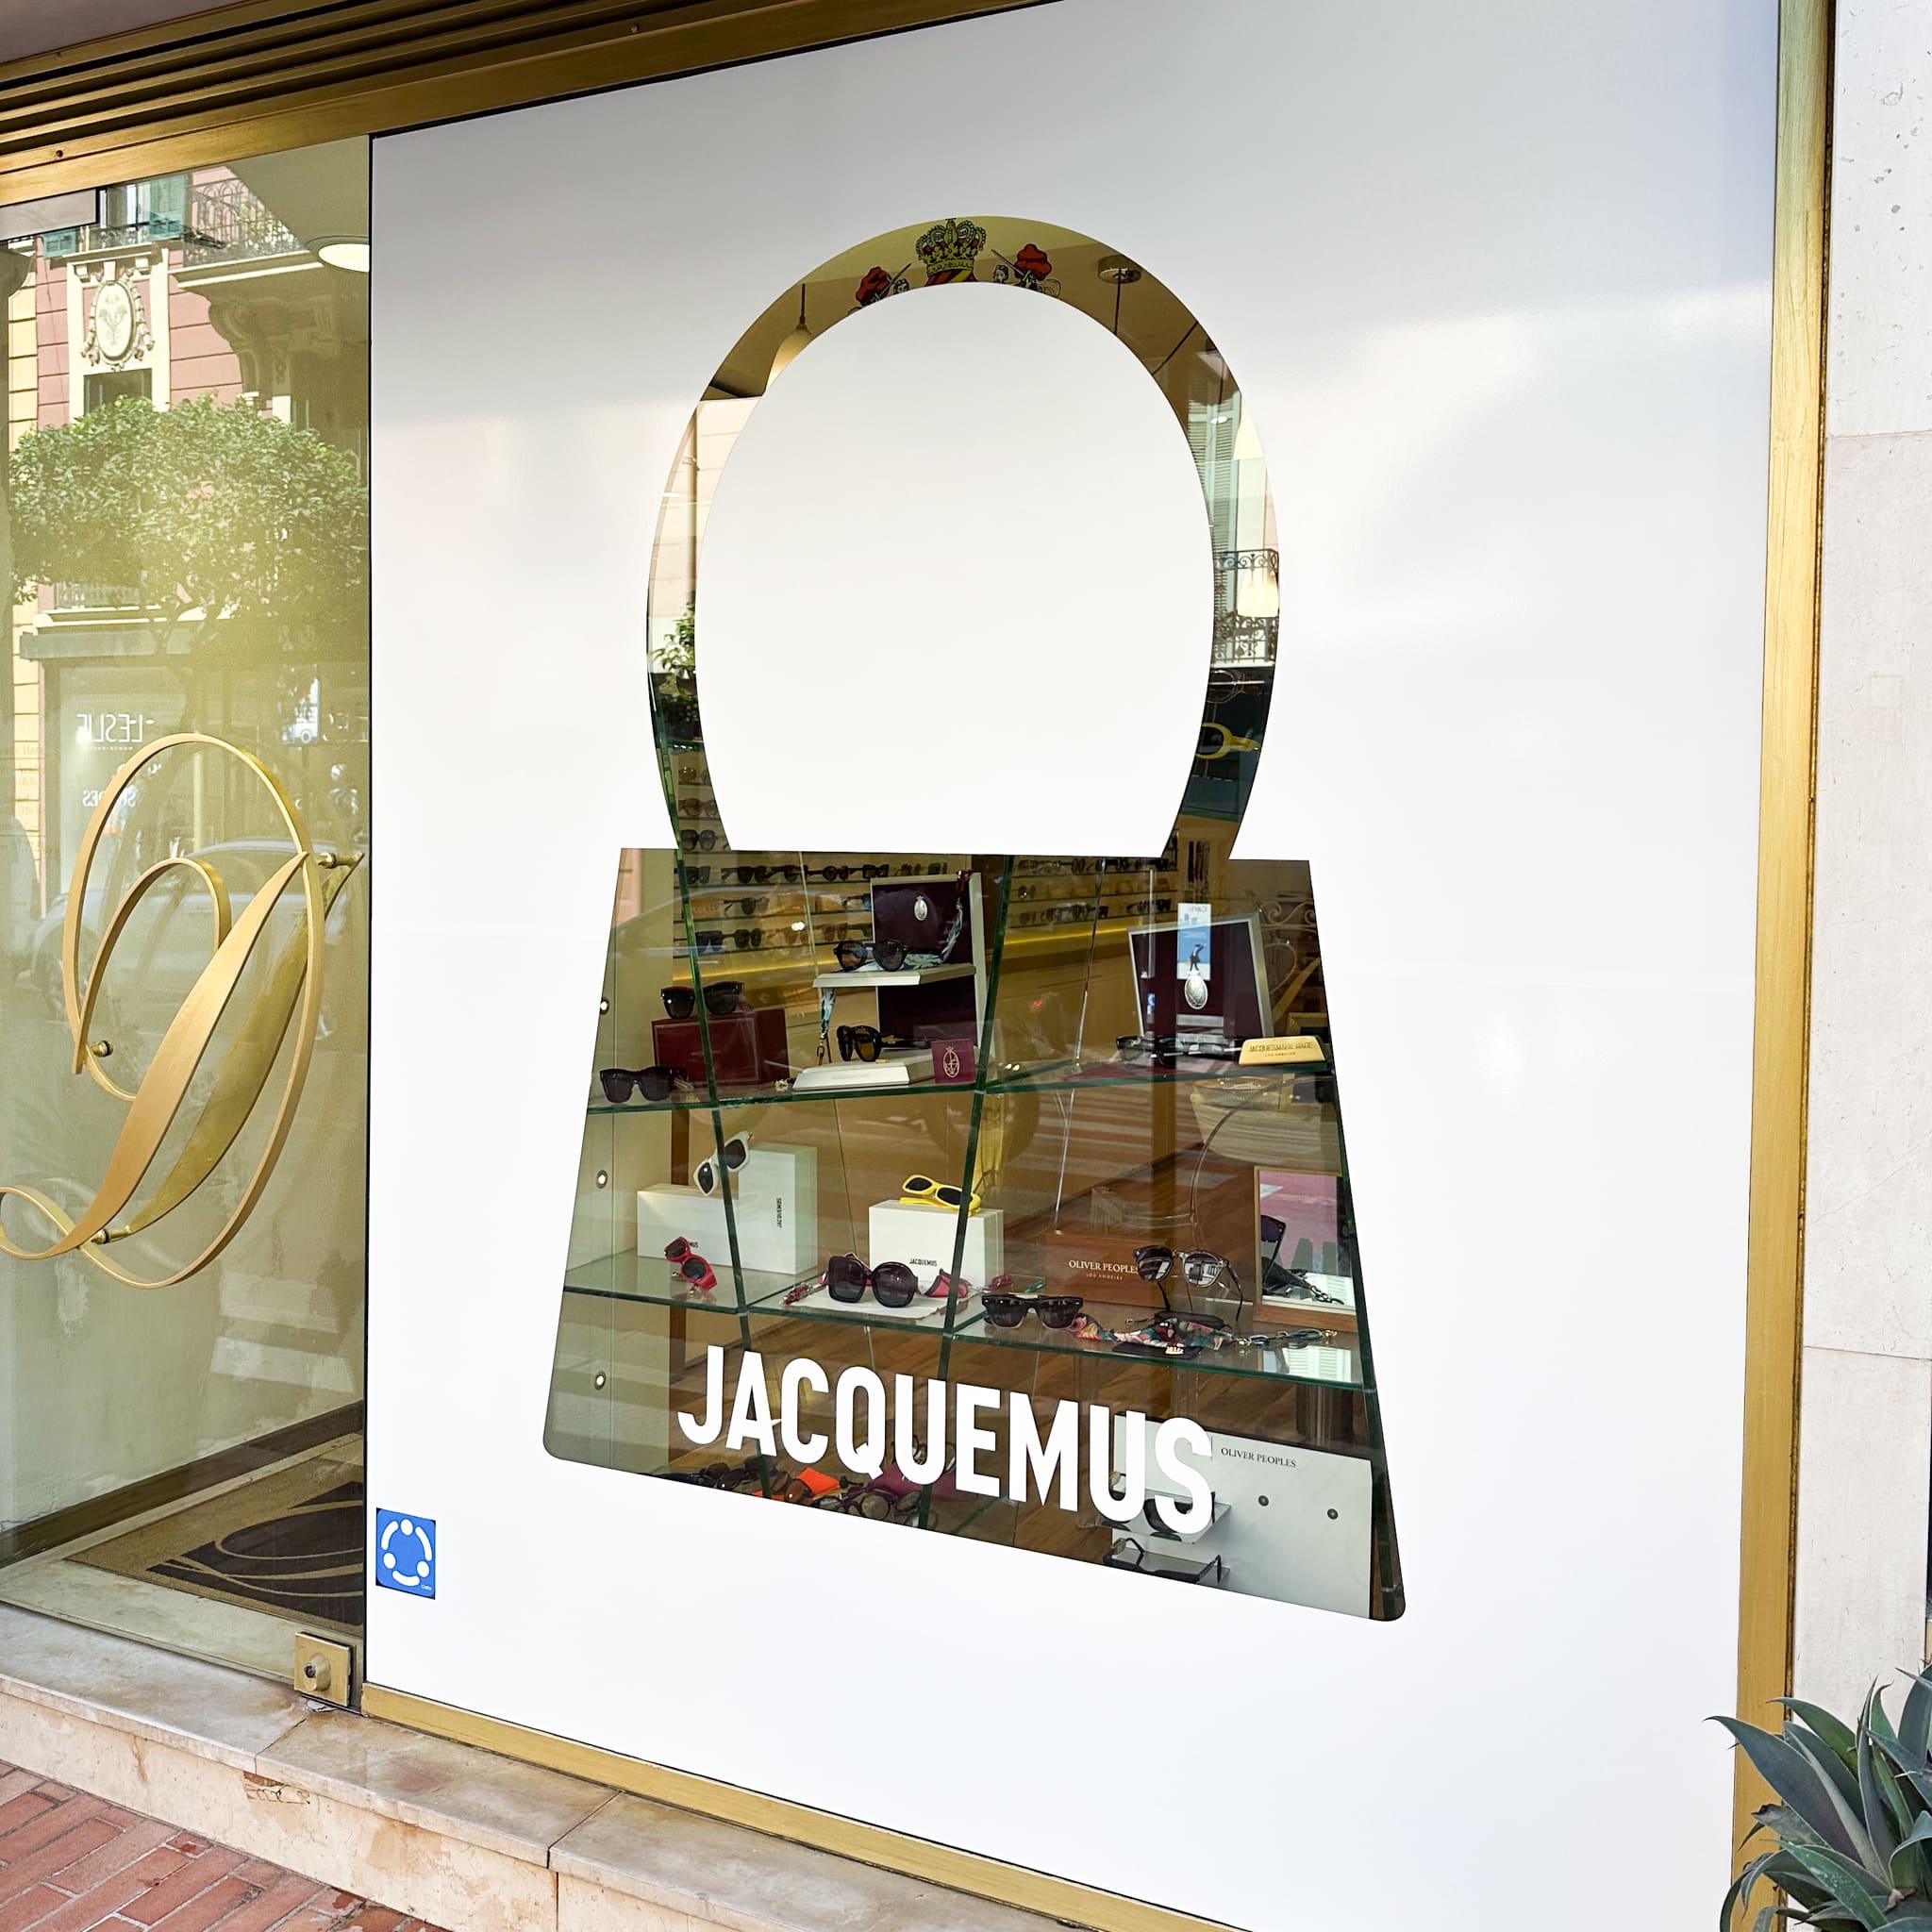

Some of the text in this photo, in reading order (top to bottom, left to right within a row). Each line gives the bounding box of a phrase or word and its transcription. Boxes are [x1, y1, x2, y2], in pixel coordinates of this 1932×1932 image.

[1068, 1259, 1102, 1271] OLIVER
[677, 1345, 1212, 1535] JACQUEMUS
[1221, 1447, 1296, 1468] OLIVER PEOPLES
